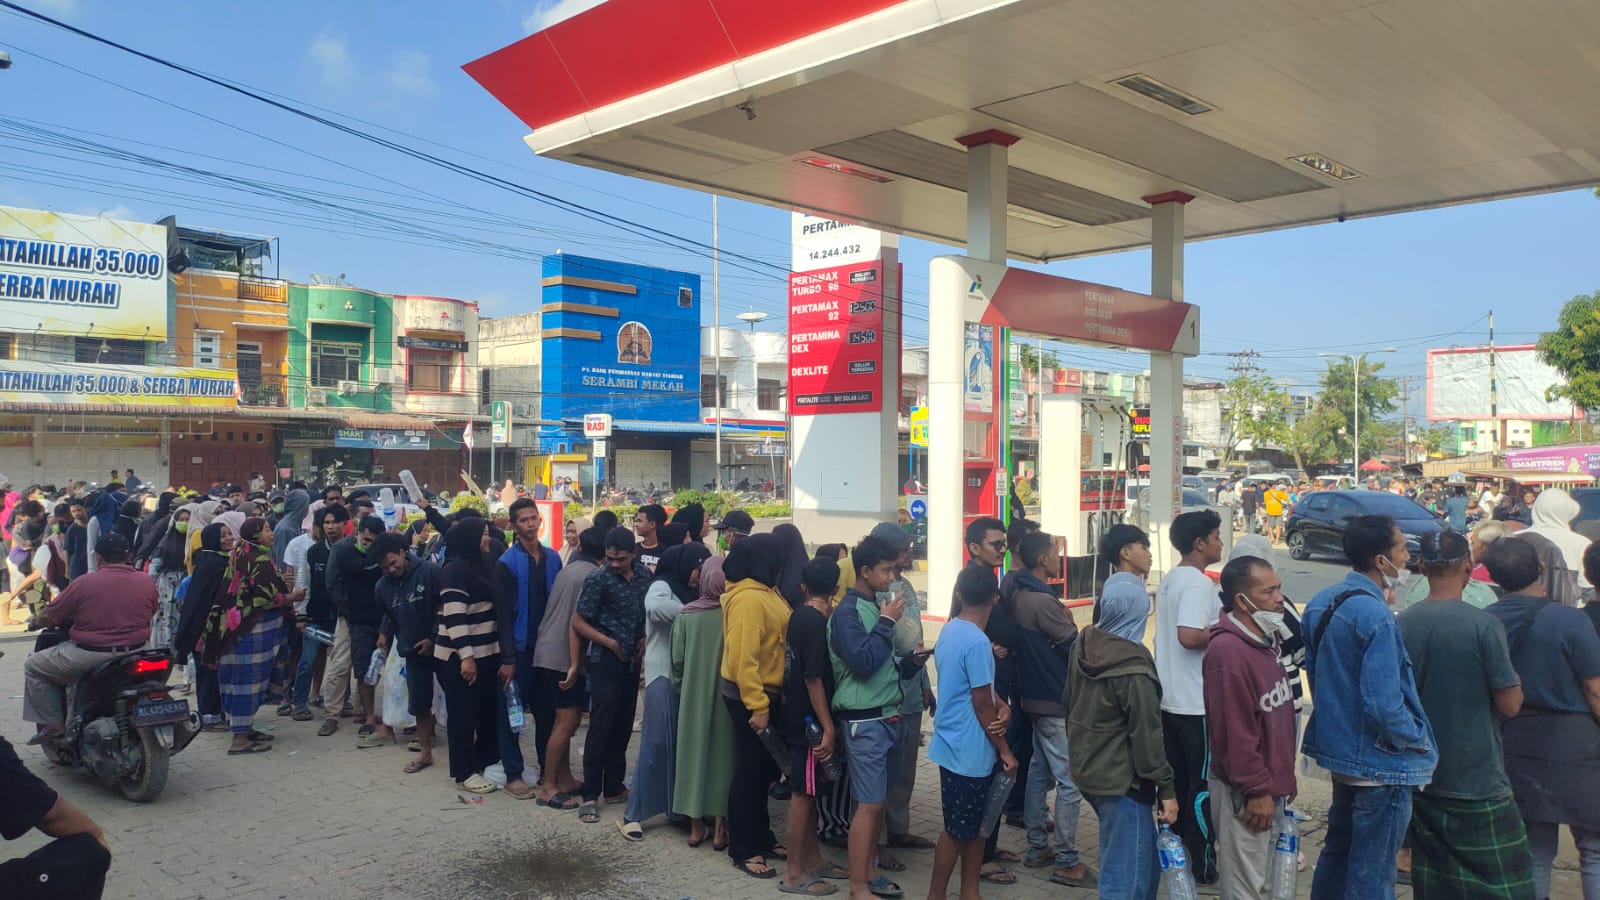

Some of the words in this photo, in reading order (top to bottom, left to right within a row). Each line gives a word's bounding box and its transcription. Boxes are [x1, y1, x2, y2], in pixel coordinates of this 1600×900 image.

[809, 244, 861, 261] 14.244.432
[95, 248, 160, 276] 35.000
[791, 271, 839, 286] PERTAMAX
[49, 278, 117, 305] MURAH
[791, 285, 822, 297] TURBO
[791, 300, 839, 315] PERTAMAX
[828, 311, 839, 321] 92
[791, 329, 840, 344] PERTAMINA
[1190, 320, 1196, 340] 1
[791, 343, 809, 353] DEX
[791, 364, 829, 377] DEXLITE
[75, 375, 126, 393] 35.000
[130, 380, 140, 392] &
[143, 377, 186, 395] SERBA
[188, 378, 235, 396] MURAH
[582, 375, 638, 389] SERAMBI
[641, 380, 685, 392] MEKAH
[338, 430, 364, 438] SMART
[586, 422, 605, 432] RASI
[1511, 460, 1565, 468] SMARTFREN
